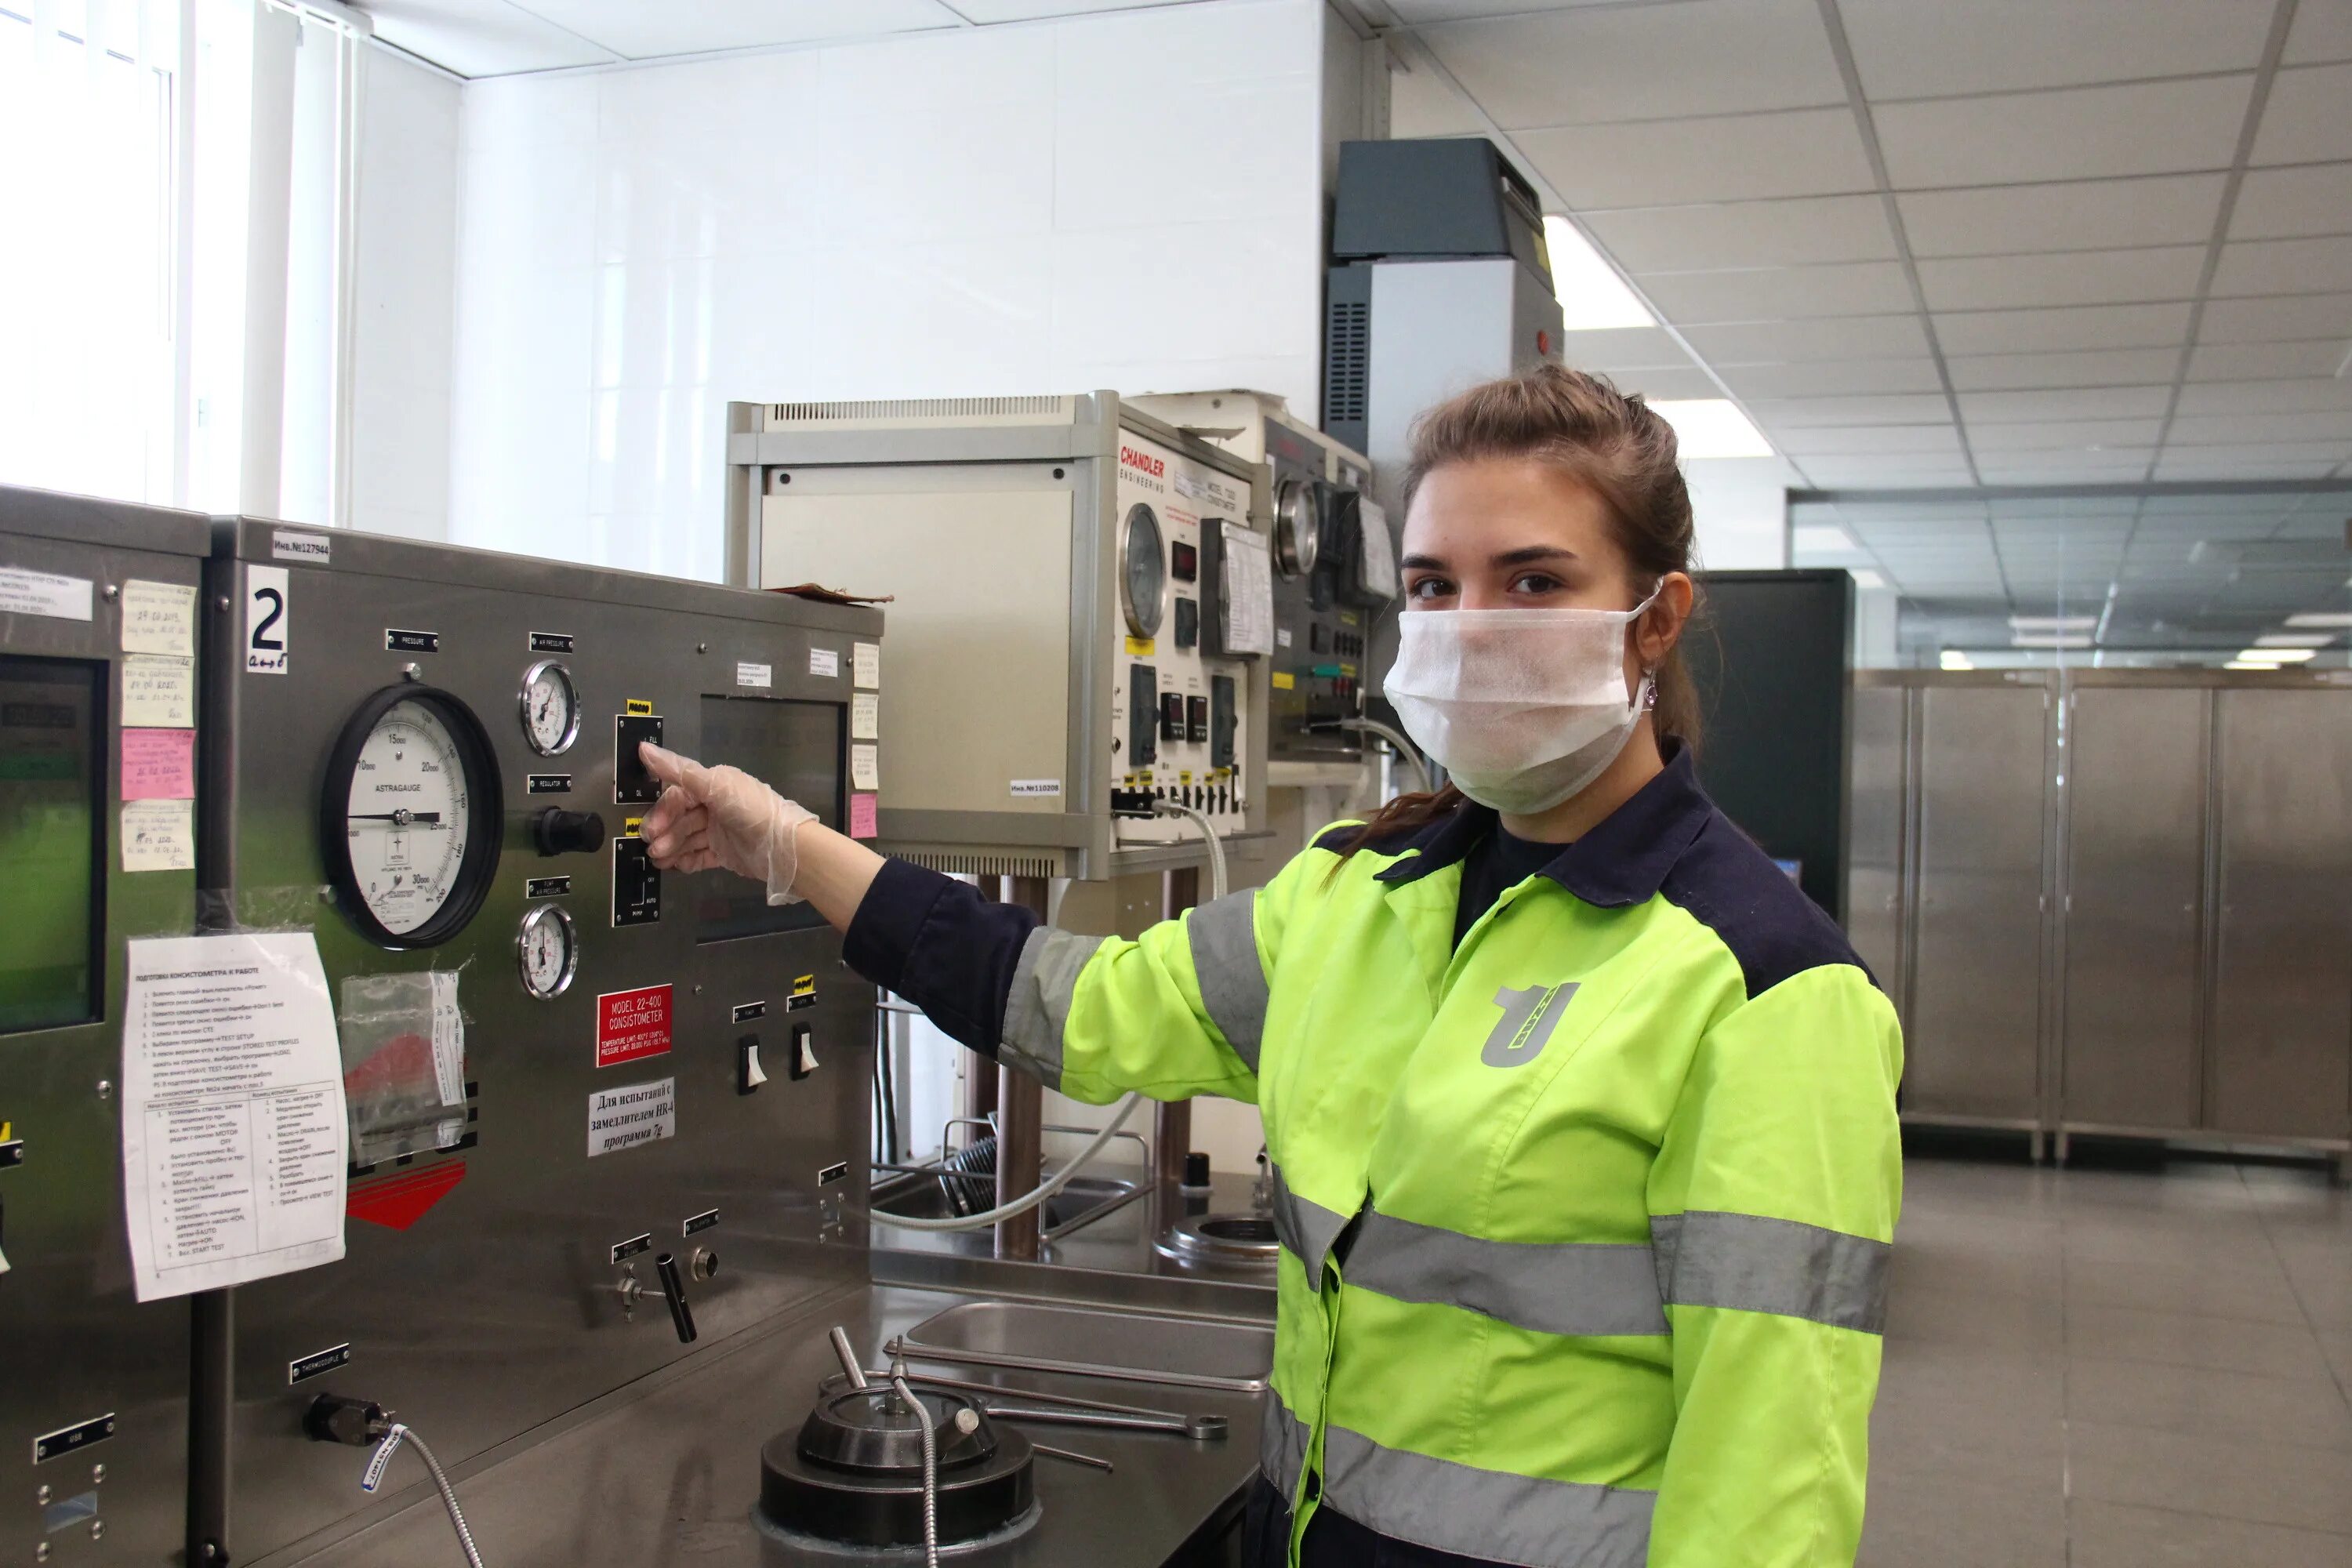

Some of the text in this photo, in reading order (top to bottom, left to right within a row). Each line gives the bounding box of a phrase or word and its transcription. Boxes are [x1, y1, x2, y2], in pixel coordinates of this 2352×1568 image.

[1120, 446, 1165, 479] CHANDLER
[1120, 468, 1164, 495] ENGINEERING
[274, 540, 329, 555] Инв.№127944
[252, 587, 283, 651] 2
[401, 637, 425, 646] PRESSURE
[546, 639, 564, 648] PRESSURE
[649, 735, 658, 744] FILL
[376, 783, 421, 793] ASTRAGAUGE
[612, 994, 662, 1015] MODEL 22-400
[609, 1009, 663, 1030] CONSISTOMETER
[601, 1036, 626, 1049] TEMPERATURE
[601, 1045, 620, 1057] PRESSURE
[597, 1083, 671, 1112] Для испытаний с
[591, 1099, 673, 1131] замедлителем HR-4
[604, 1127, 652, 1151] программа
